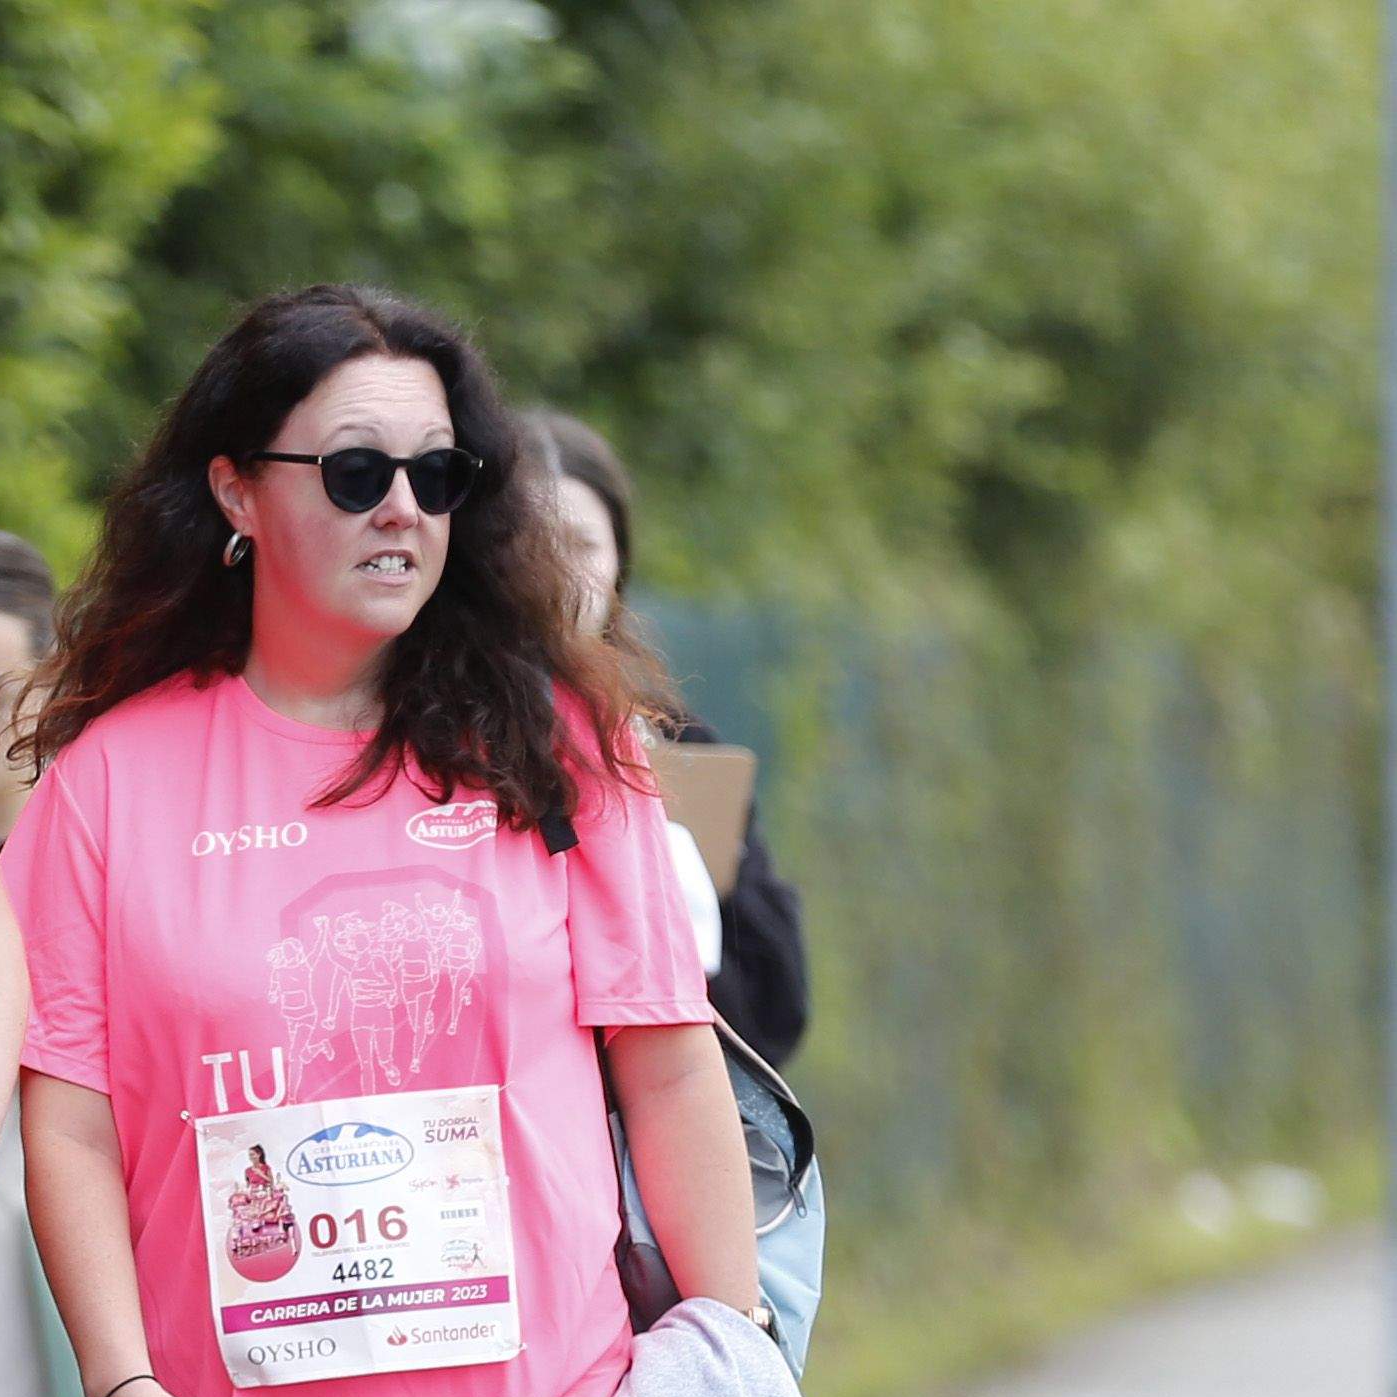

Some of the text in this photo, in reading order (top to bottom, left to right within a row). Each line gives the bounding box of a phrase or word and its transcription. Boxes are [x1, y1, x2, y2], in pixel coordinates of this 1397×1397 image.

[192, 821, 308, 856] OYSHO
[201, 1046, 286, 1113] TU
[424, 1126, 479, 1143] SUMA
[438, 1116, 479, 1127] DORSAL
[297, 1148, 404, 1175] ASTURIANA
[309, 1205, 408, 1249] 016
[333, 1257, 395, 1283] 4482
[251, 1284, 488, 1324] CARRERA DE LA MUJER 2023
[411, 1321, 496, 1344] Santander
[247, 1337, 337, 1366] OYSHO
